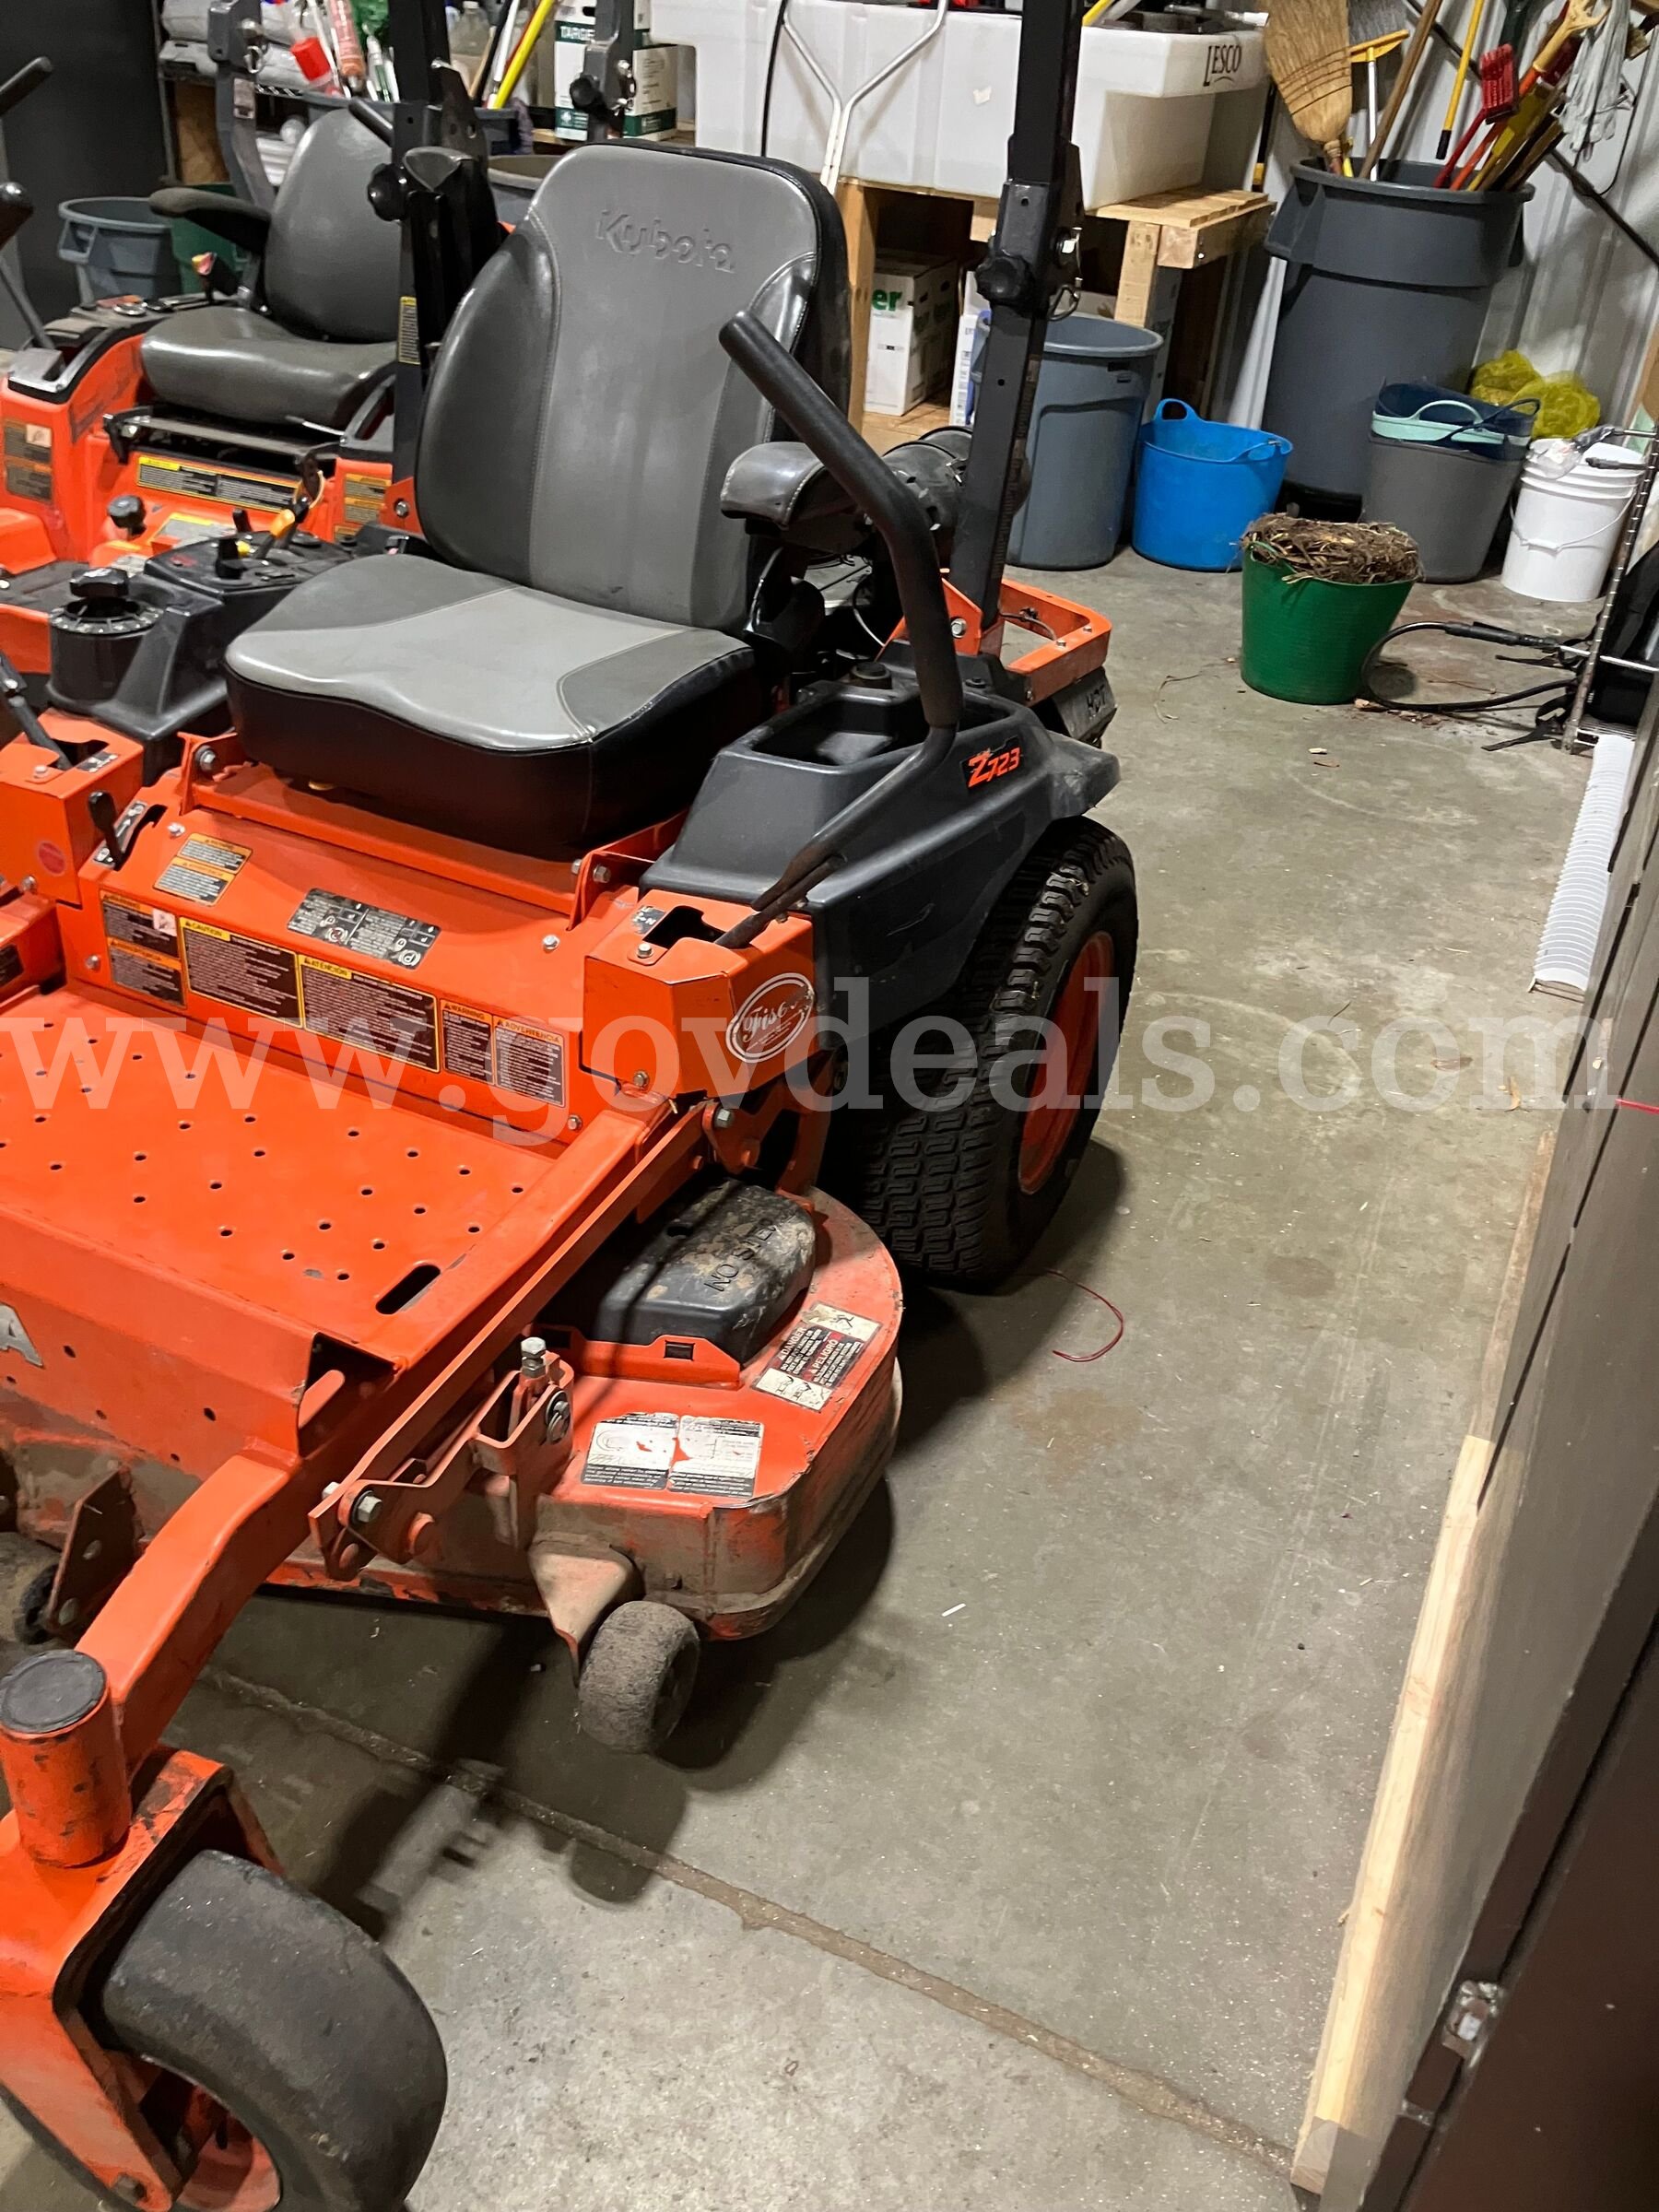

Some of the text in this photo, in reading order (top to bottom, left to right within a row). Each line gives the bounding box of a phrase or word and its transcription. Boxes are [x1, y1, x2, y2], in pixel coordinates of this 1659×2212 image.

[1203, 43, 1242, 87] LESCO
[596, 208, 735, 274] Kubota
[968, 747, 1022, 788] Z723
[703, 1264, 739, 1292] NO
